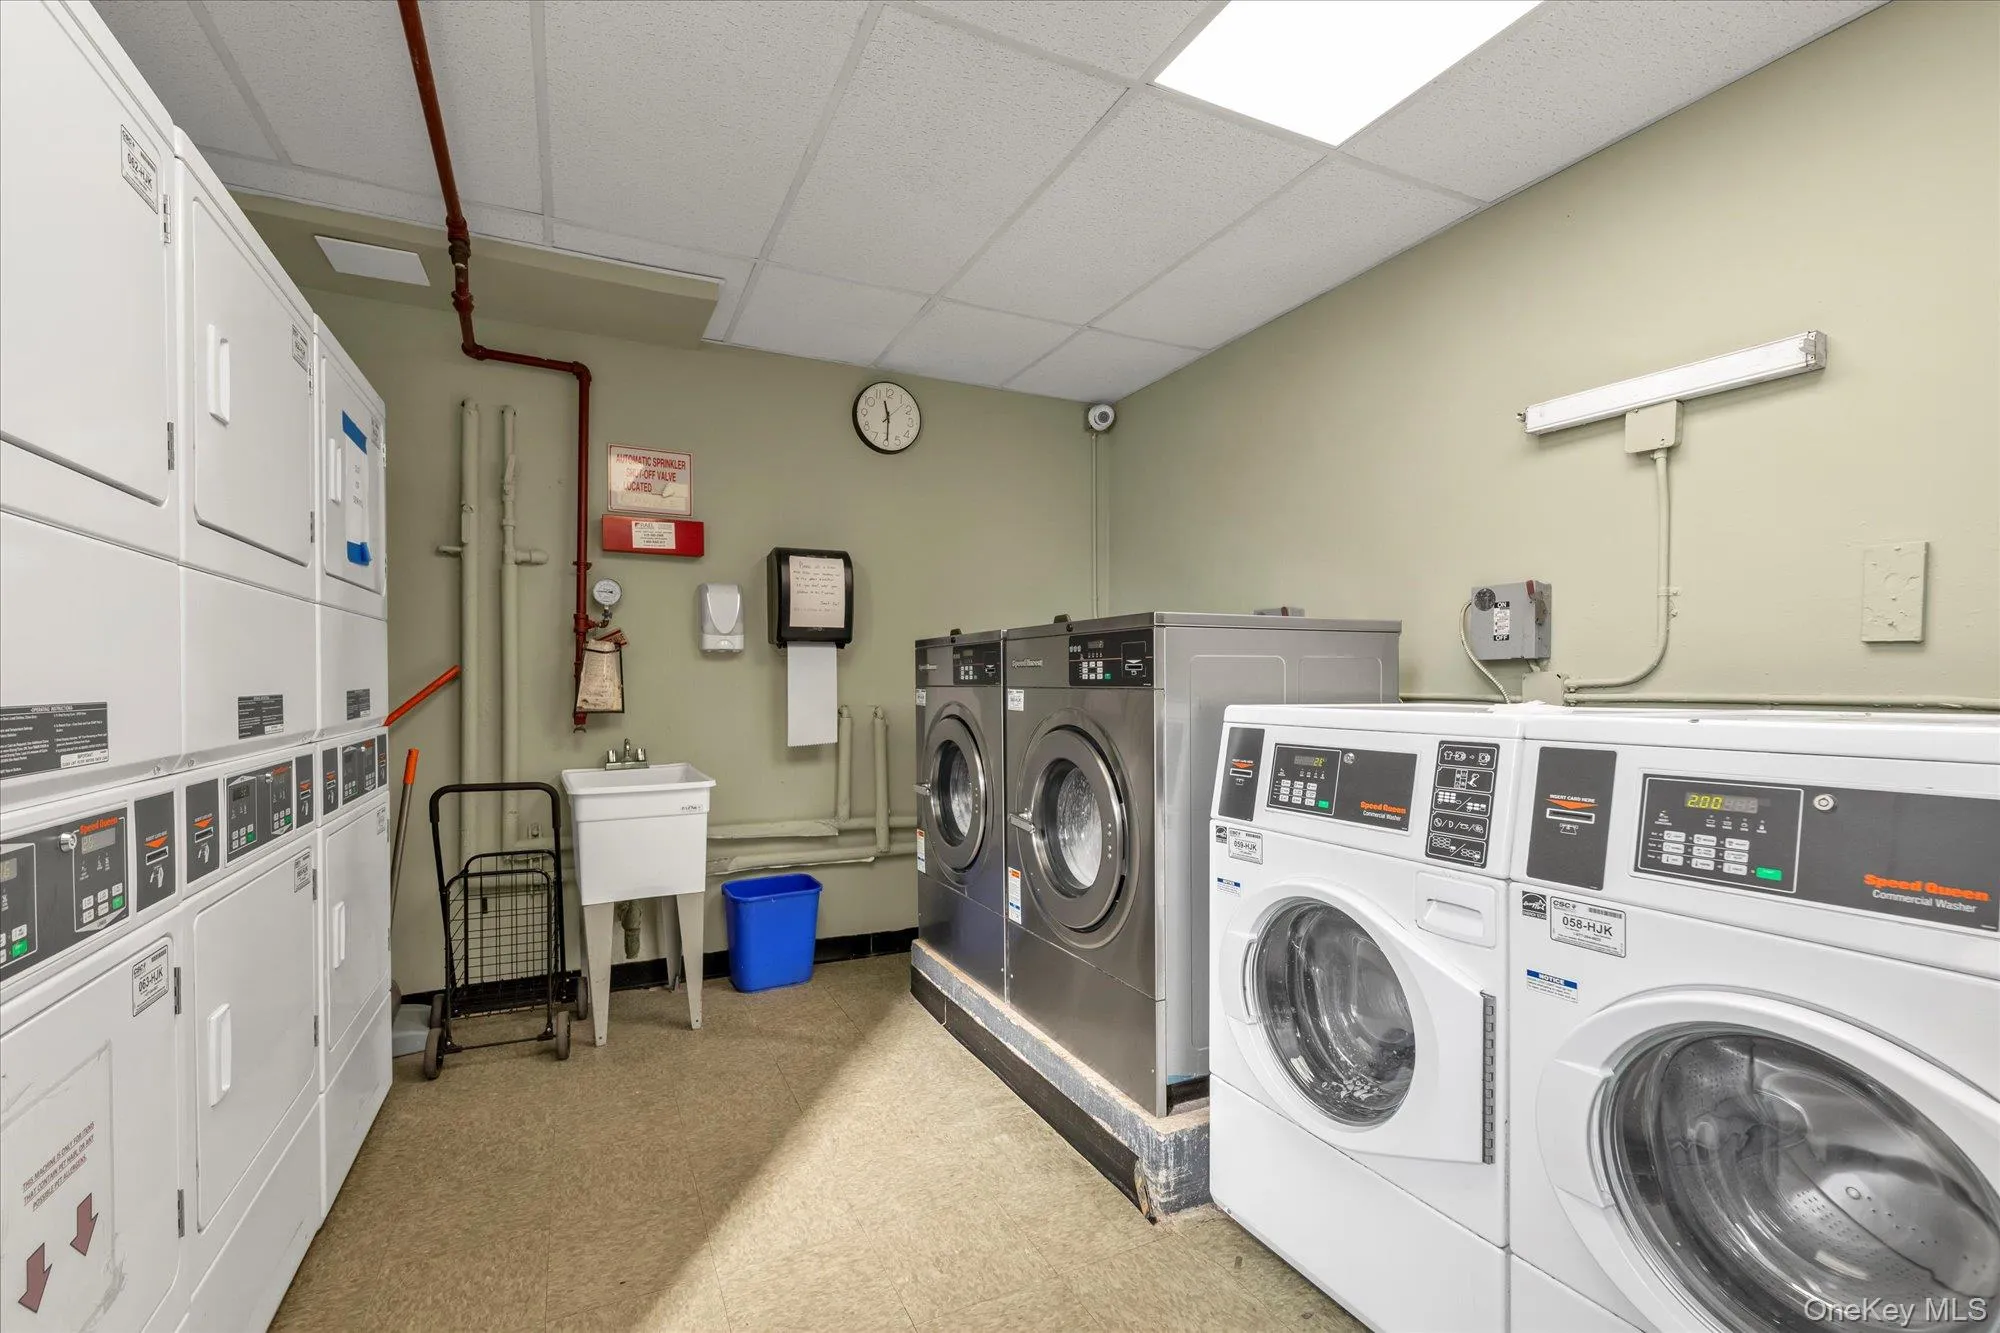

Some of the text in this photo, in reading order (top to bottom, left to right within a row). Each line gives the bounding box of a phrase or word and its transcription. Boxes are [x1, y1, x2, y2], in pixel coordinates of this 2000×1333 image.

[876, 388, 882, 399] 11
[886, 388, 894, 399] 12
[865, 396, 875, 407] 10
[861, 408, 868, 418] 9
[905, 405, 912, 415] 2
[864, 420, 870, 431] 8
[907, 417, 914, 428] 3
[871, 430, 878, 441] 7
[903, 430, 910, 438] 4
[895, 436, 901, 446] 5
[616, 454, 686, 470] AUTOMATIC SPRINKLER
[657, 471, 676, 482] VALVE
[624, 482, 652, 492] LOCATED
[1688, 794, 1722, 809] 2.00
[1360, 801, 1406, 814] Speed Queen
[80, 816, 119, 835] Speed Queen
[1864, 874, 1989, 902] Speed Queen
[1553, 900, 1570, 908] CSC
[1872, 889, 1977, 913] Commercial Washer
[1562, 917, 1613, 936] 058-HJK
[139, 967, 163, 992] 063-HJK
[1539, 973, 1564, 985] NOTICE
